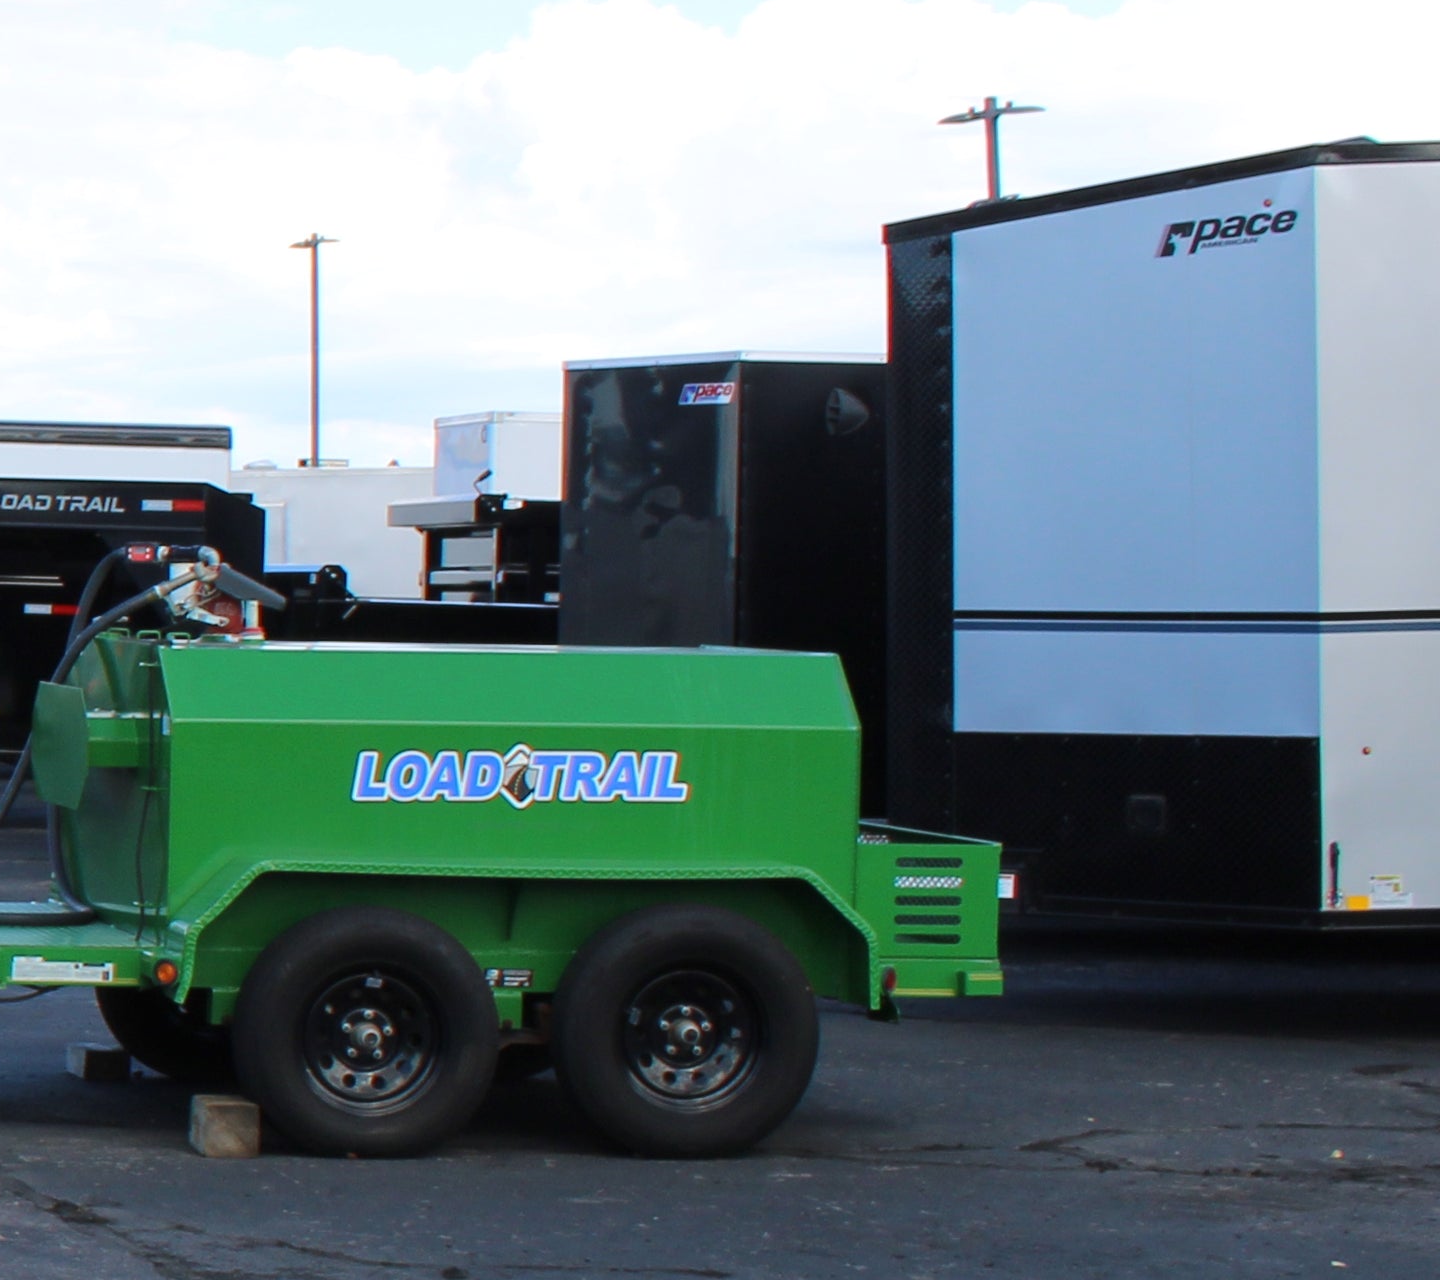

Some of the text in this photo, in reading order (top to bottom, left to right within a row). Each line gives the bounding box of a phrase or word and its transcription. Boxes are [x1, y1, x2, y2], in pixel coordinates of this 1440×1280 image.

[1188, 209, 1298, 255] pace
[56, 495, 126, 512] TRAIL
[352, 750, 688, 802] LOAD TRAIL
